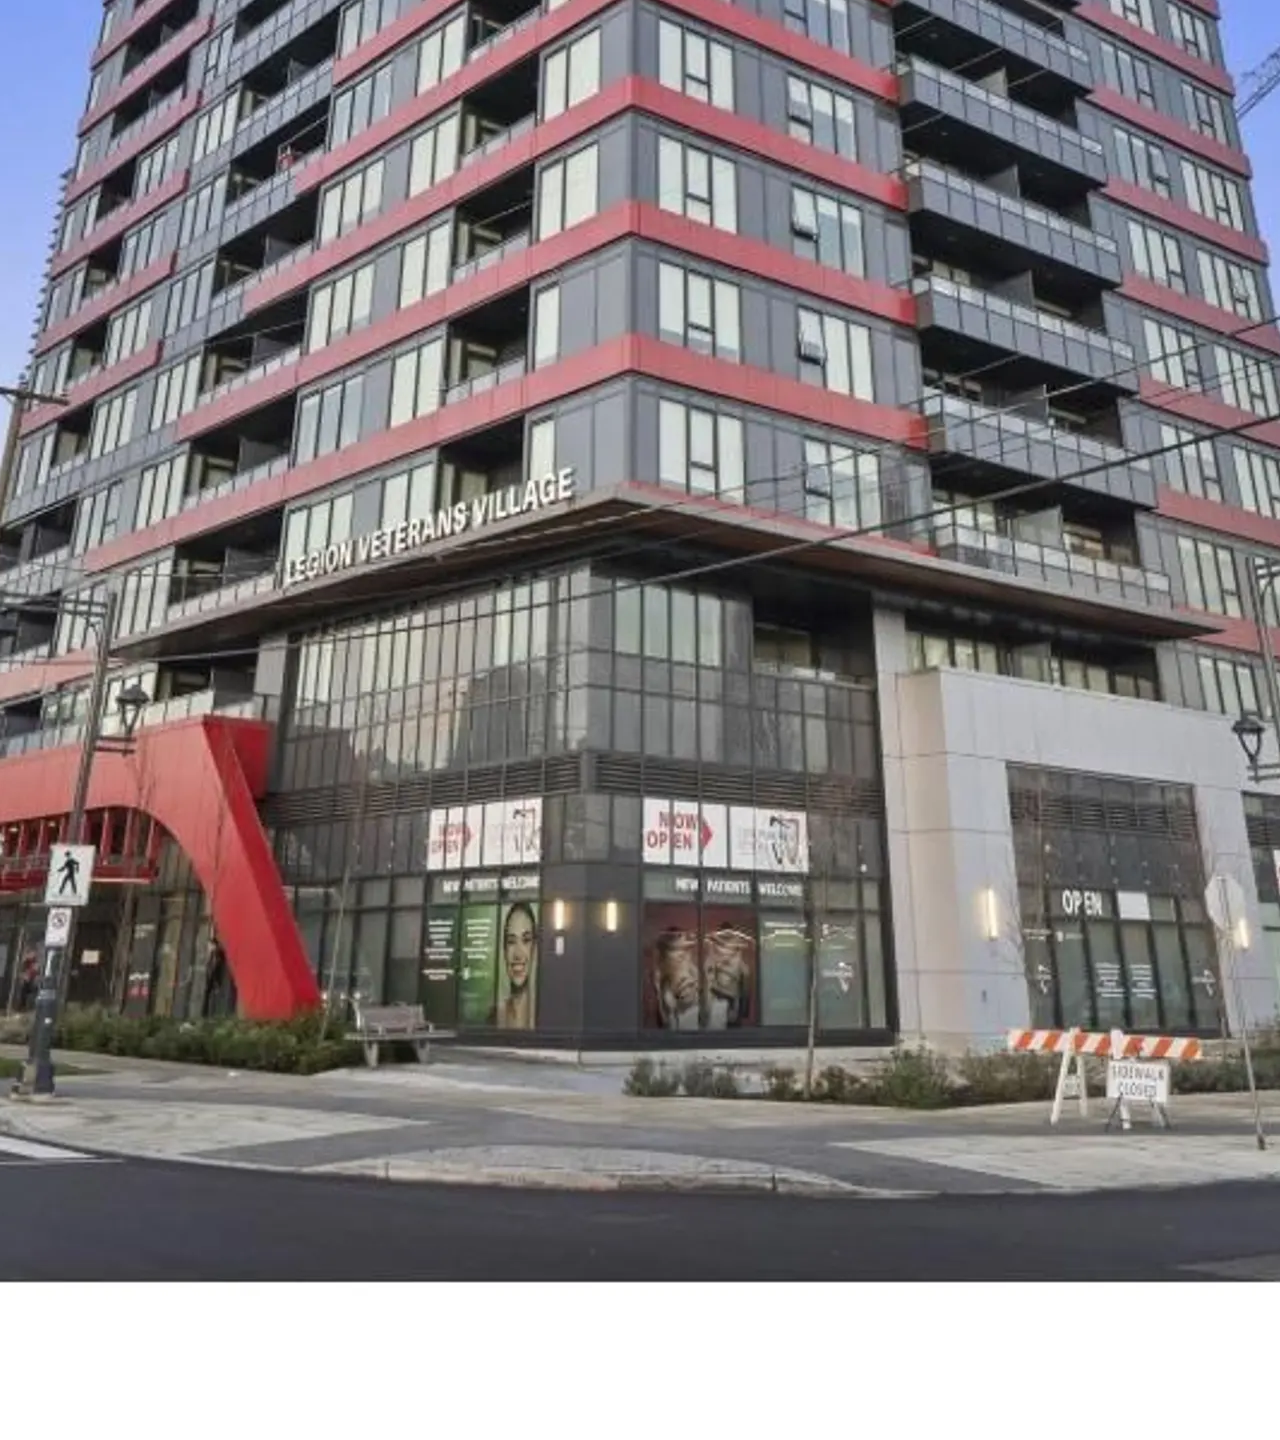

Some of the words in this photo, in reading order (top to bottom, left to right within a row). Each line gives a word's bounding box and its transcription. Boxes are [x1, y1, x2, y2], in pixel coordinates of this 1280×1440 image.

[286, 540, 353, 583] LEGION
[358, 502, 468, 559] VETERANS
[471, 467, 574, 525] VILLAGE
[658, 811, 698, 830] NOW
[646, 831, 693, 851] OPEN
[1062, 888, 1103, 917] OPEN
[1111, 1063, 1165, 1080] SIDEWALK
[1118, 1082, 1157, 1098] CLOSED
